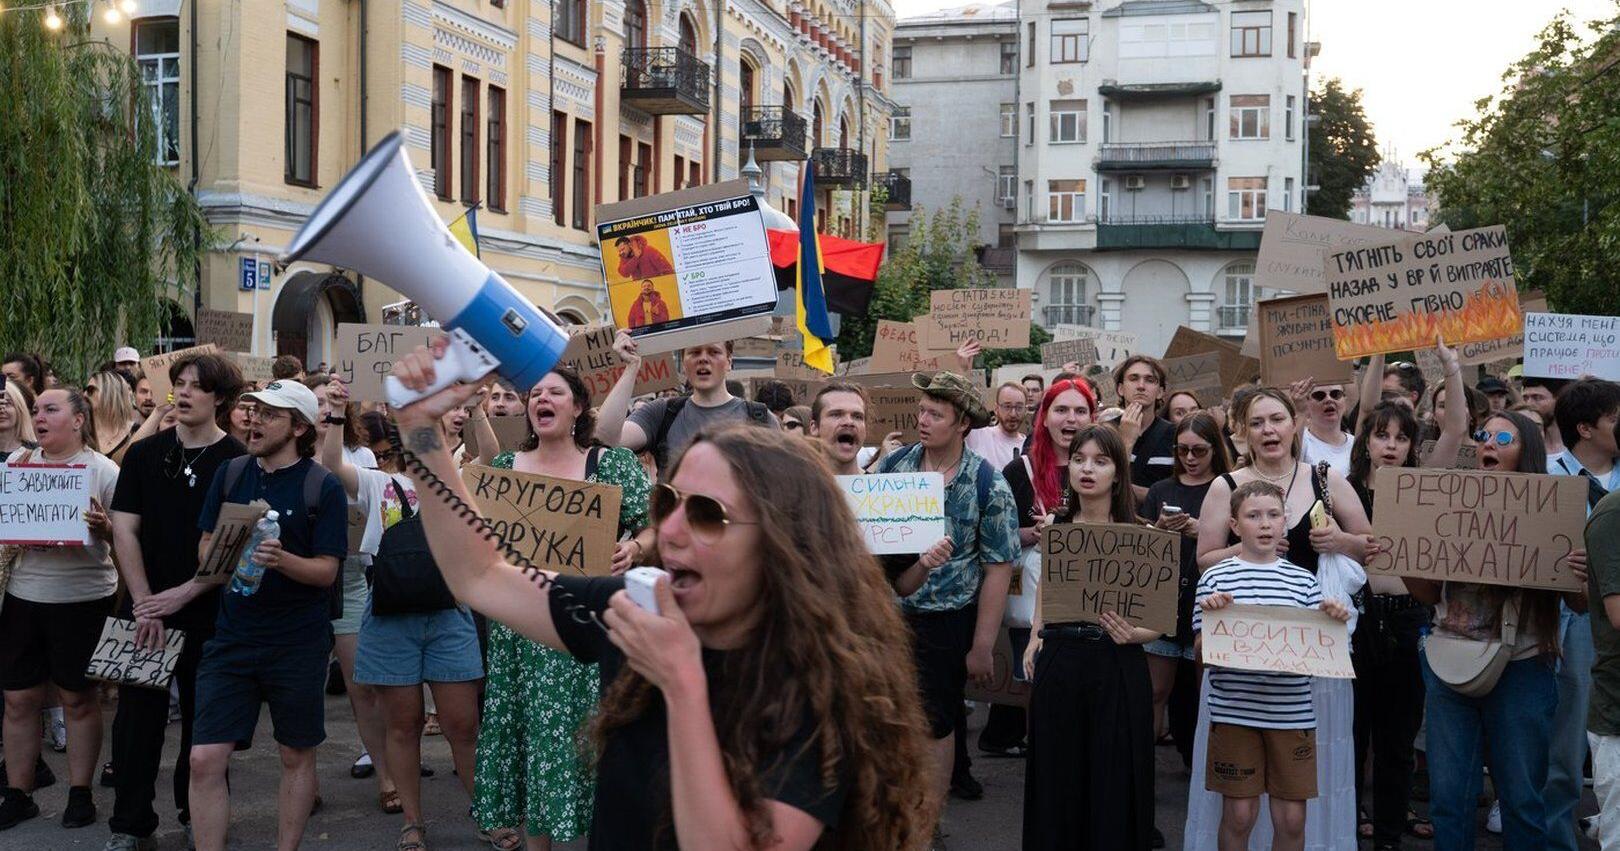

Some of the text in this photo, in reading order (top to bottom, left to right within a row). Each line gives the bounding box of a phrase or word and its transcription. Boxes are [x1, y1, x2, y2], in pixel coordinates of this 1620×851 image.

[699, 205, 714, 216] ХТО
[715, 202, 732, 212] ТВІЙ
[733, 199, 751, 209] БРО!
[693, 223, 707, 231] БРО
[1332, 231, 1508, 273] ТЯГНІТЬ СВОЇ СРАКИ
[246, 272, 254, 287] 5
[691, 270, 706, 279] БРО
[1330, 256, 1513, 299] НАЗАД У ВР Й ВИПРАВТЕ
[951, 289, 988, 302] СТАТТЯ
[1335, 301, 1398, 327] СКОЄНЕ
[1411, 291, 1464, 315] ГІВНО
[1527, 315, 1573, 329] НАХУЯ
[358, 332, 403, 354] БАГ
[950, 328, 1009, 343] НАРОД!
[1463, 338, 1501, 359] GREAT
[1530, 348, 1579, 360] ПРАЦЮЄ
[587, 351, 614, 370] ЩЕ
[18, 470, 84, 493] ЗАВАЖАЙТЕ
[851, 477, 931, 494] СИЛЬНА
[475, 472, 603, 519] КРУГОВА
[1396, 472, 1559, 514] РЕФОРМИ
[0, 503, 79, 524] ЕРЕМАГАТИ
[852, 493, 942, 516] УКРАЇНА
[1435, 511, 1519, 544] СТАЛИ
[1048, 528, 1178, 566] ВОЛОДЬКА,
[1048, 559, 1173, 591] НЕ ПОЗОР
[1082, 588, 1146, 620] МЕНЕ
[1211, 619, 1336, 648] ДОСИТЬ
[1209, 651, 1231, 662] НЕ
